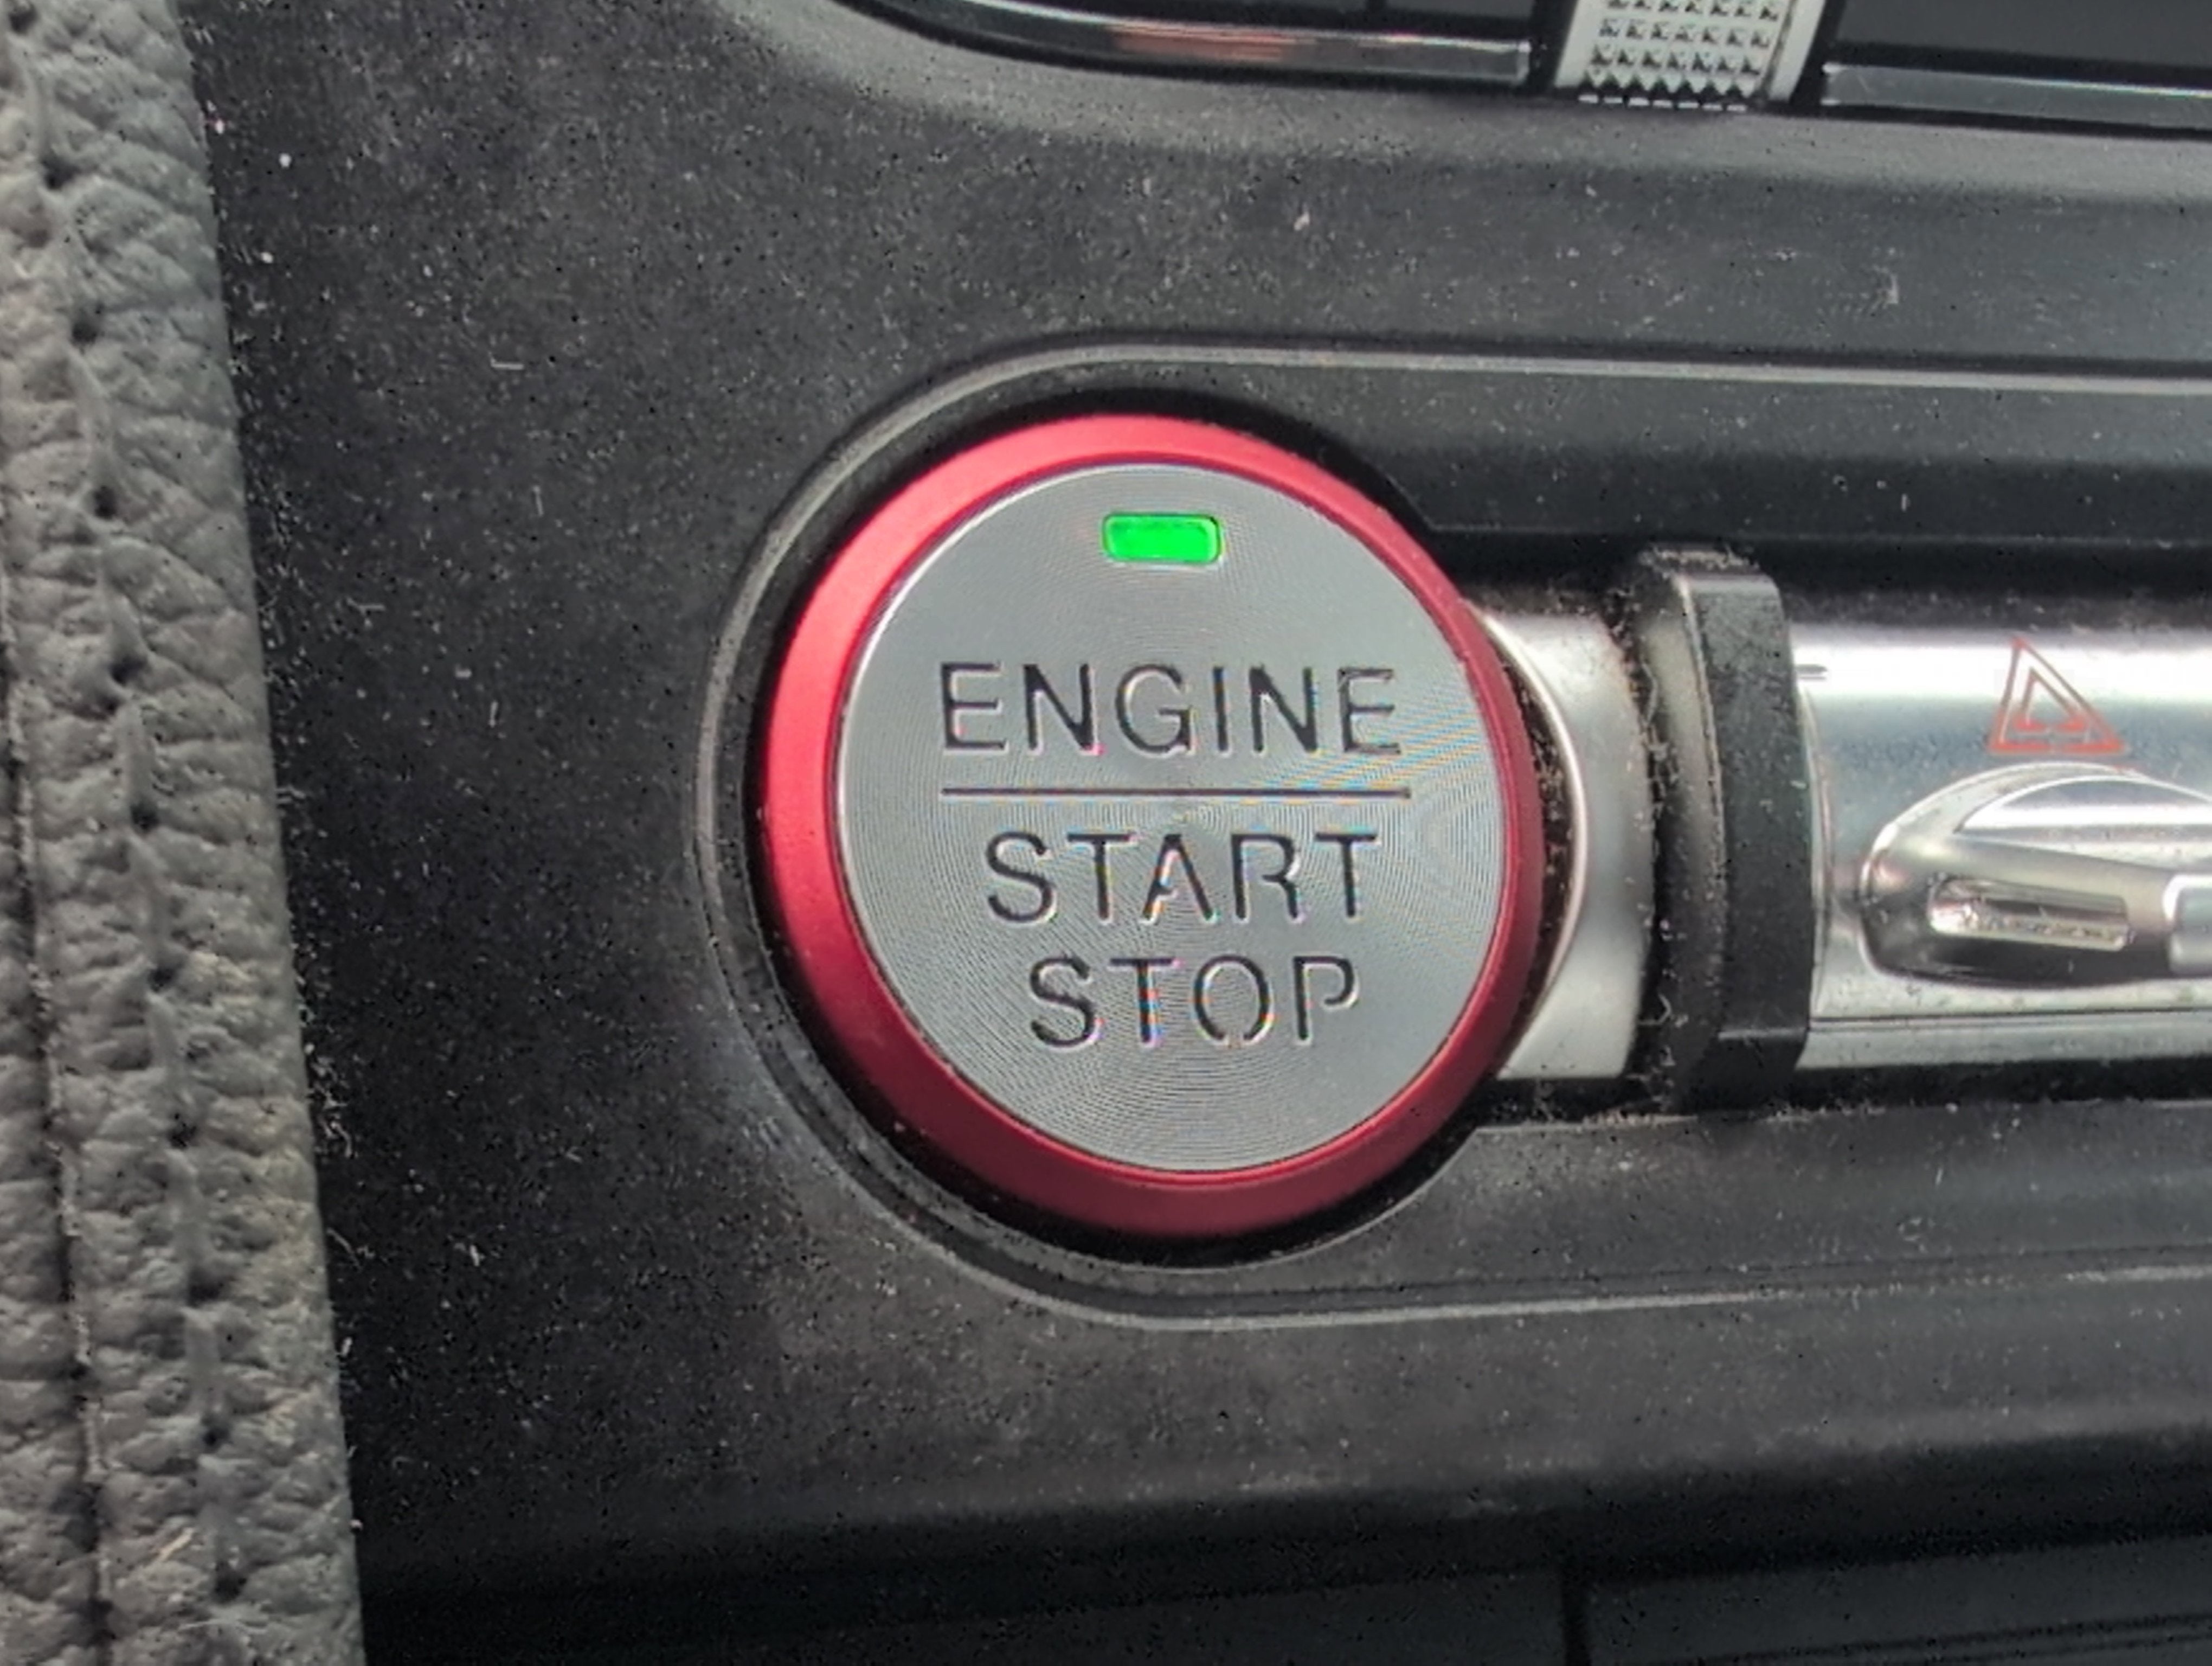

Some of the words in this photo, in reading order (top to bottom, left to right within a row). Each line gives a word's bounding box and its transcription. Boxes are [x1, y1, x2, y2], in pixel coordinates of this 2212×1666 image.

[940, 662, 1401, 754] ENGINE
[986, 831, 1379, 924] START
[1028, 954, 1357, 1047] STOP
